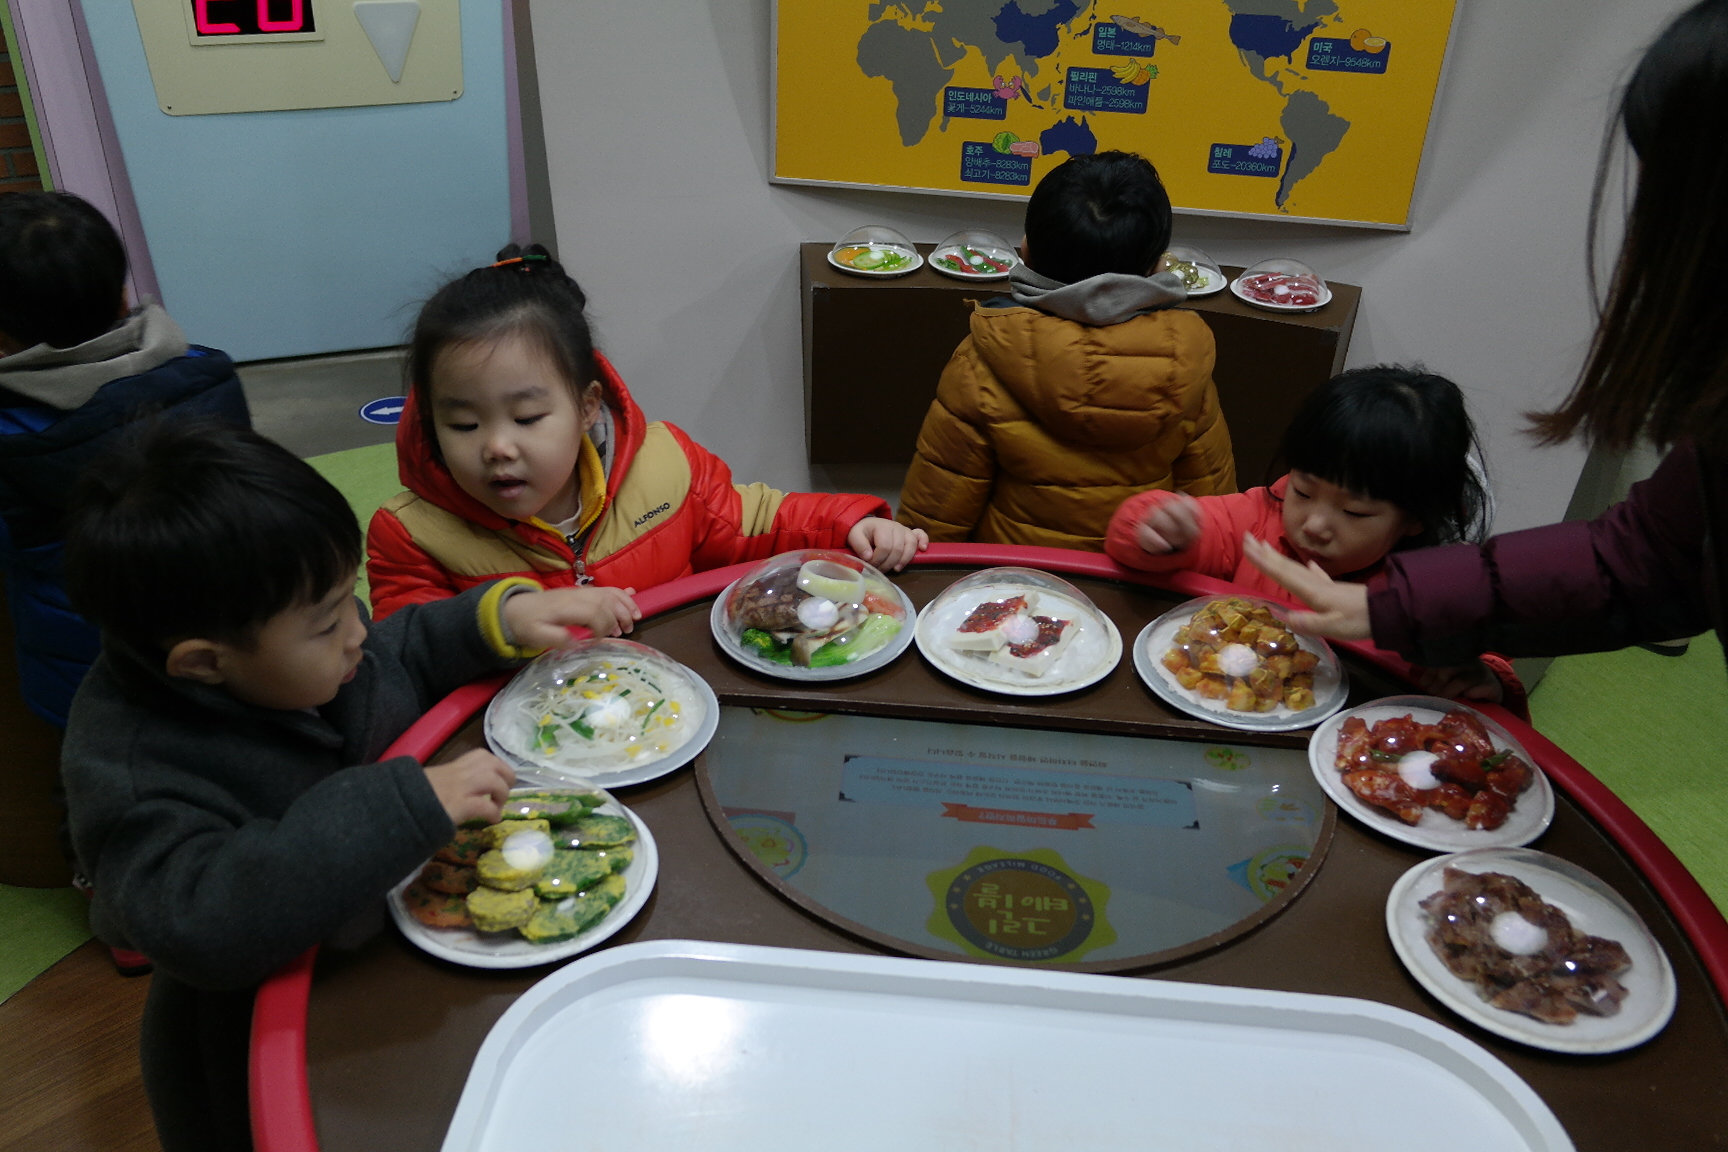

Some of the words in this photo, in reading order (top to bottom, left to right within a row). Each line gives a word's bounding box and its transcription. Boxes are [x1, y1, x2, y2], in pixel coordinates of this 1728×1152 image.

[1098, 26, 1117, 38] 일본
[1097, 39, 1151, 52] 명태-1214km
[1313, 42, 1333, 53] 미국
[1310, 55, 1381, 68] 오렌지-9548km
[1070, 71, 1097, 84] 필리핀
[948, 90, 992, 103] 인도네시아
[1069, 84, 1135, 97] 바나나-2598km
[1067, 95, 1142, 109] 파인애플-2598km
[965, 145, 983, 156] 호주
[965, 157, 1029, 170] 양배추-8283km
[1212, 160, 1276, 172] 포도-20360km
[964, 168, 1028, 182] 쇠고기-8283km
[634, 502, 671, 528] ALFONSO
[973, 883, 1069, 912] 테이블
[989, 910, 1051, 936] 그린
[985, 941, 1019, 957] TABLE
[1021, 945, 1059, 959] GREEN
